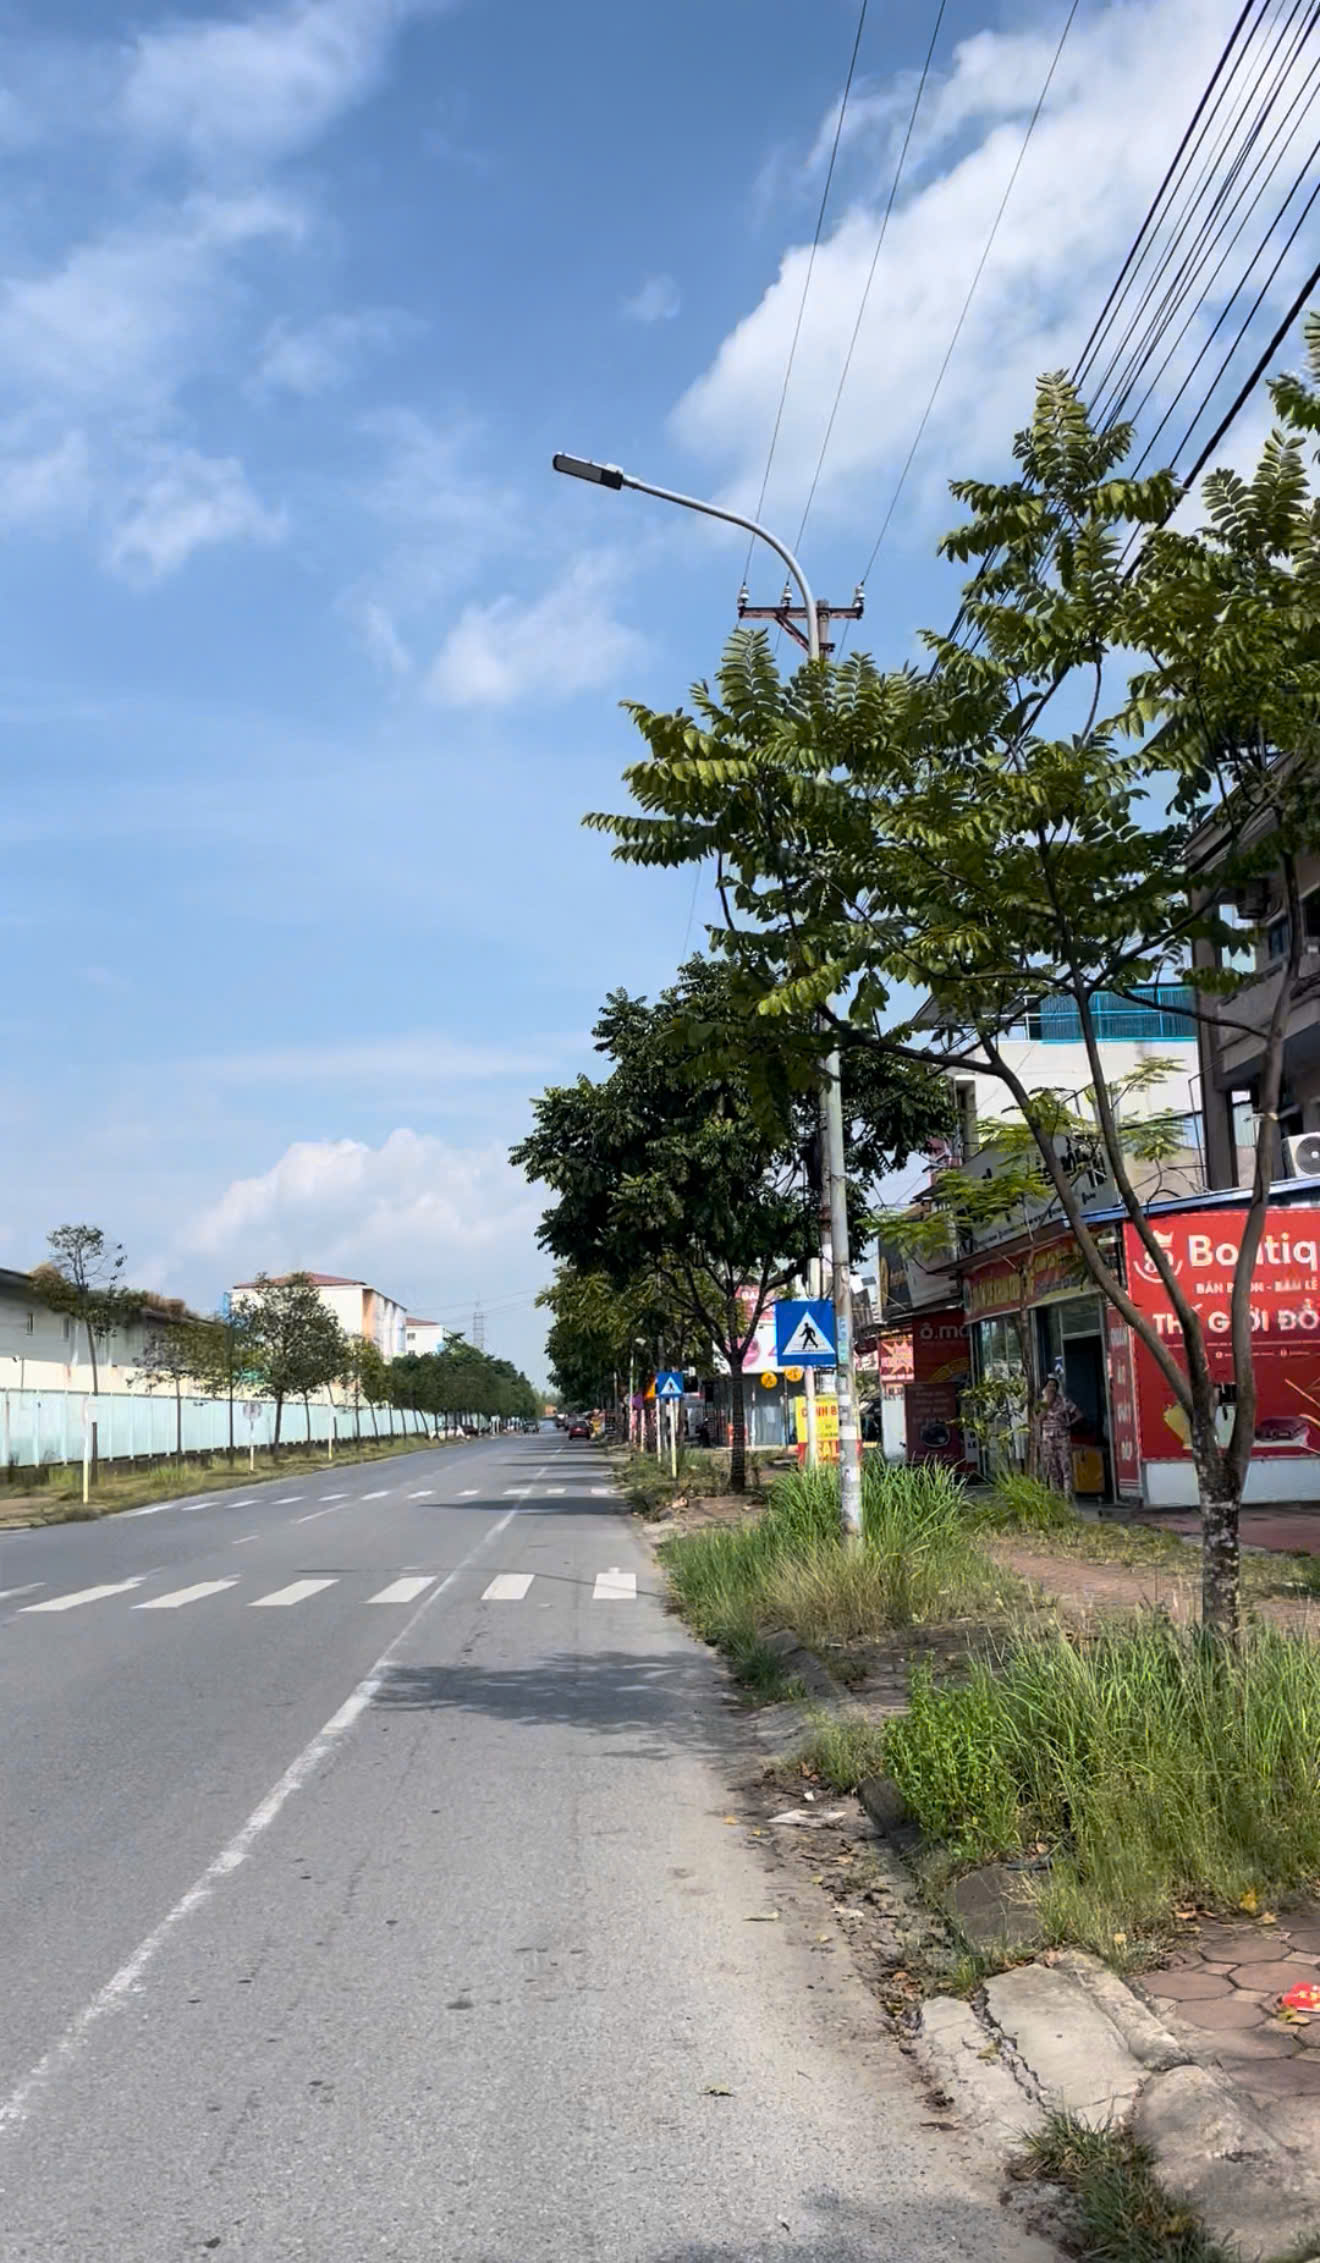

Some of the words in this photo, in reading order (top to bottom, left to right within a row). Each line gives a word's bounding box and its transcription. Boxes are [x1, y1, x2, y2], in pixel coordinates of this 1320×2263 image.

[1188, 1233, 1317, 1271] Botiq
[1226, 1281, 1265, 1293] BN
[1152, 1303, 1203, 1335] TH
